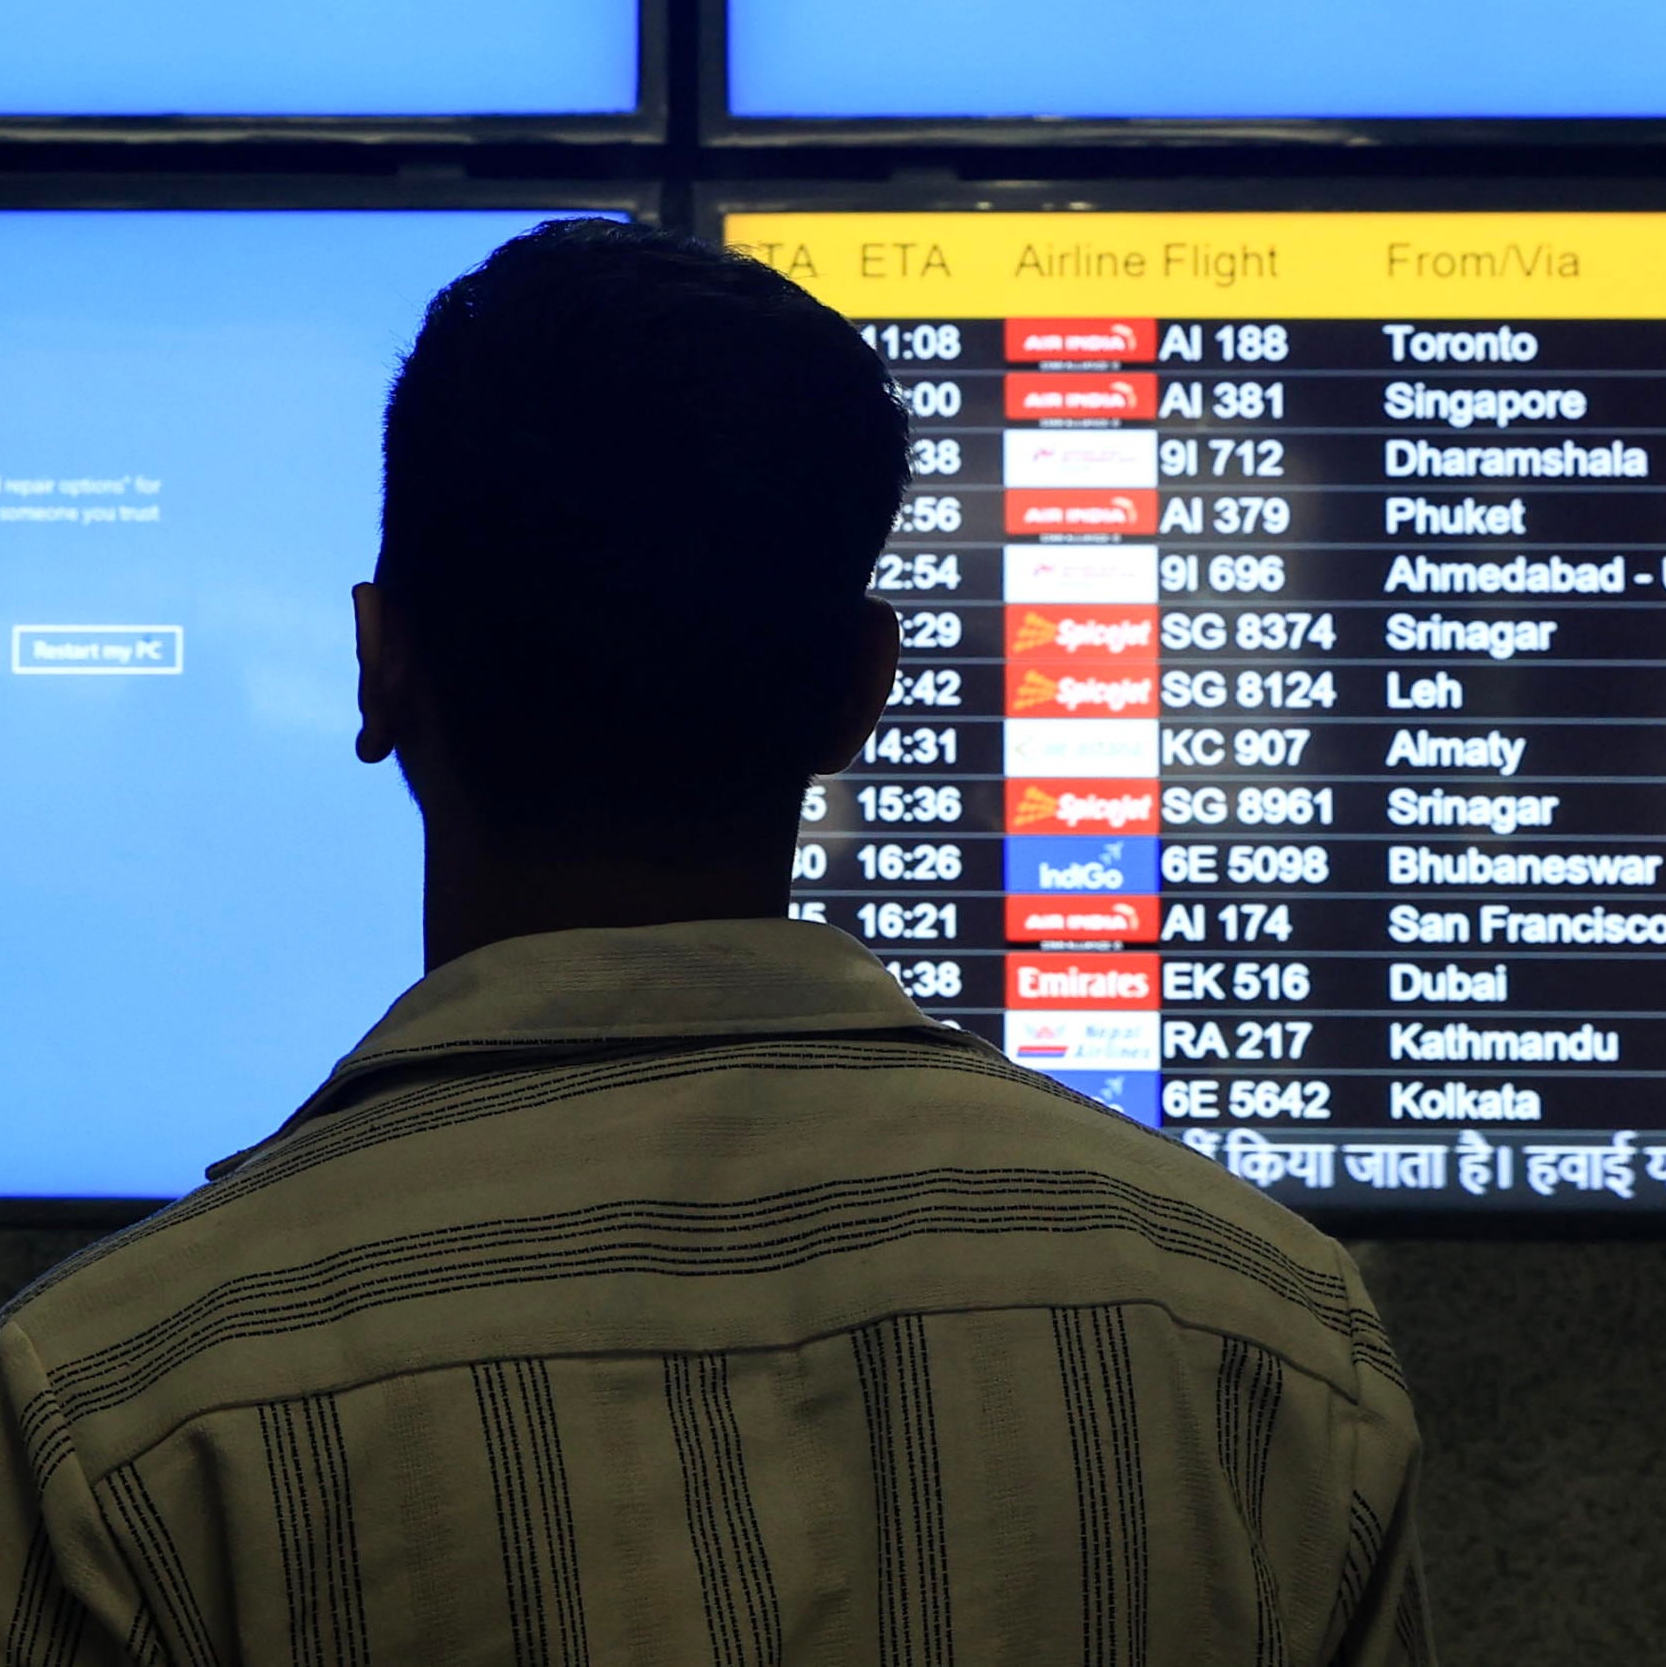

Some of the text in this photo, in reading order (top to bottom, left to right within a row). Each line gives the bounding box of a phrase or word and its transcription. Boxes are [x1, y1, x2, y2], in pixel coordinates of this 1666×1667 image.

[739, 242, 817, 279] TA
[860, 242, 951, 279] ETA
[1014, 243, 1147, 278] Airline
[1163, 242, 1278, 288] Flight
[1387, 242, 1580, 279] From/Via
[1159, 324, 1202, 361] AI
[1215, 324, 1289, 361] 188
[1382, 324, 1538, 362] Toronto
[903, 381, 961, 417] :00
[1159, 382, 1203, 419] AI
[1212, 381, 1283, 419] 381
[1384, 382, 1587, 428] Singapore
[1159, 439, 1198, 477] 9I
[1208, 439, 1284, 477] 712
[1386, 439, 1648, 477] Dharamshala
[891, 496, 962, 532] :56
[1159, 496, 1204, 534] AI
[1213, 496, 1290, 534] 379
[1386, 497, 1526, 535] Phuket
[868, 554, 961, 590] 2:54
[1160, 554, 1199, 592] 9I
[1208, 554, 1286, 592] 696
[1384, 555, 1625, 593] Ahmedabad
[896, 611, 962, 648] :29
[1159, 612, 1227, 650] SG
[1235, 612, 1336, 650] 8374
[1386, 613, 1558, 660] Srinagar
[33, 640, 162, 664] Restart my PC
[1159, 670, 1227, 708] SG
[1236, 670, 1337, 708] 8124
[1387, 671, 1463, 709] Leh
[1162, 728, 1226, 766] KC
[1234, 728, 1311, 766] 907
[1386, 729, 1526, 776] Almaty
[858, 786, 962, 822] 15:36
[1159, 786, 1228, 824] SG
[1236, 787, 1332, 825] 8961
[1388, 787, 1560, 835] Srinagar
[858, 844, 962, 880] 16:26
[1161, 845, 1219, 883] 6E
[1227, 845, 1329, 883] 5098
[1389, 846, 1663, 885] Bhubaneswar
[857, 903, 956, 939] 16:21
[1160, 904, 1205, 941] AI
[1218, 904, 1293, 942] 174
[1388, 904, 1470, 943] San
[885, 961, 962, 997] :38
[1017, 966, 1150, 999] Emirates
[1163, 962, 1226, 1000] EK
[1233, 962, 1310, 1000] 516
[1390, 963, 1507, 1002] Dubai
[1164, 1021, 1229, 1059] RA
[1236, 1021, 1313, 1059] 217
[1390, 1022, 1619, 1061] Kathmandu
[1162, 1080, 1220, 1118] 6E
[1229, 1080, 1331, 1119] 5642
[1391, 1081, 1541, 1120] Kolkata
[1228, 1127, 1336, 1187] किया
[1343, 1144, 1448, 1188] जाता
[1524, 1130, 1637, 1198] हवाई
